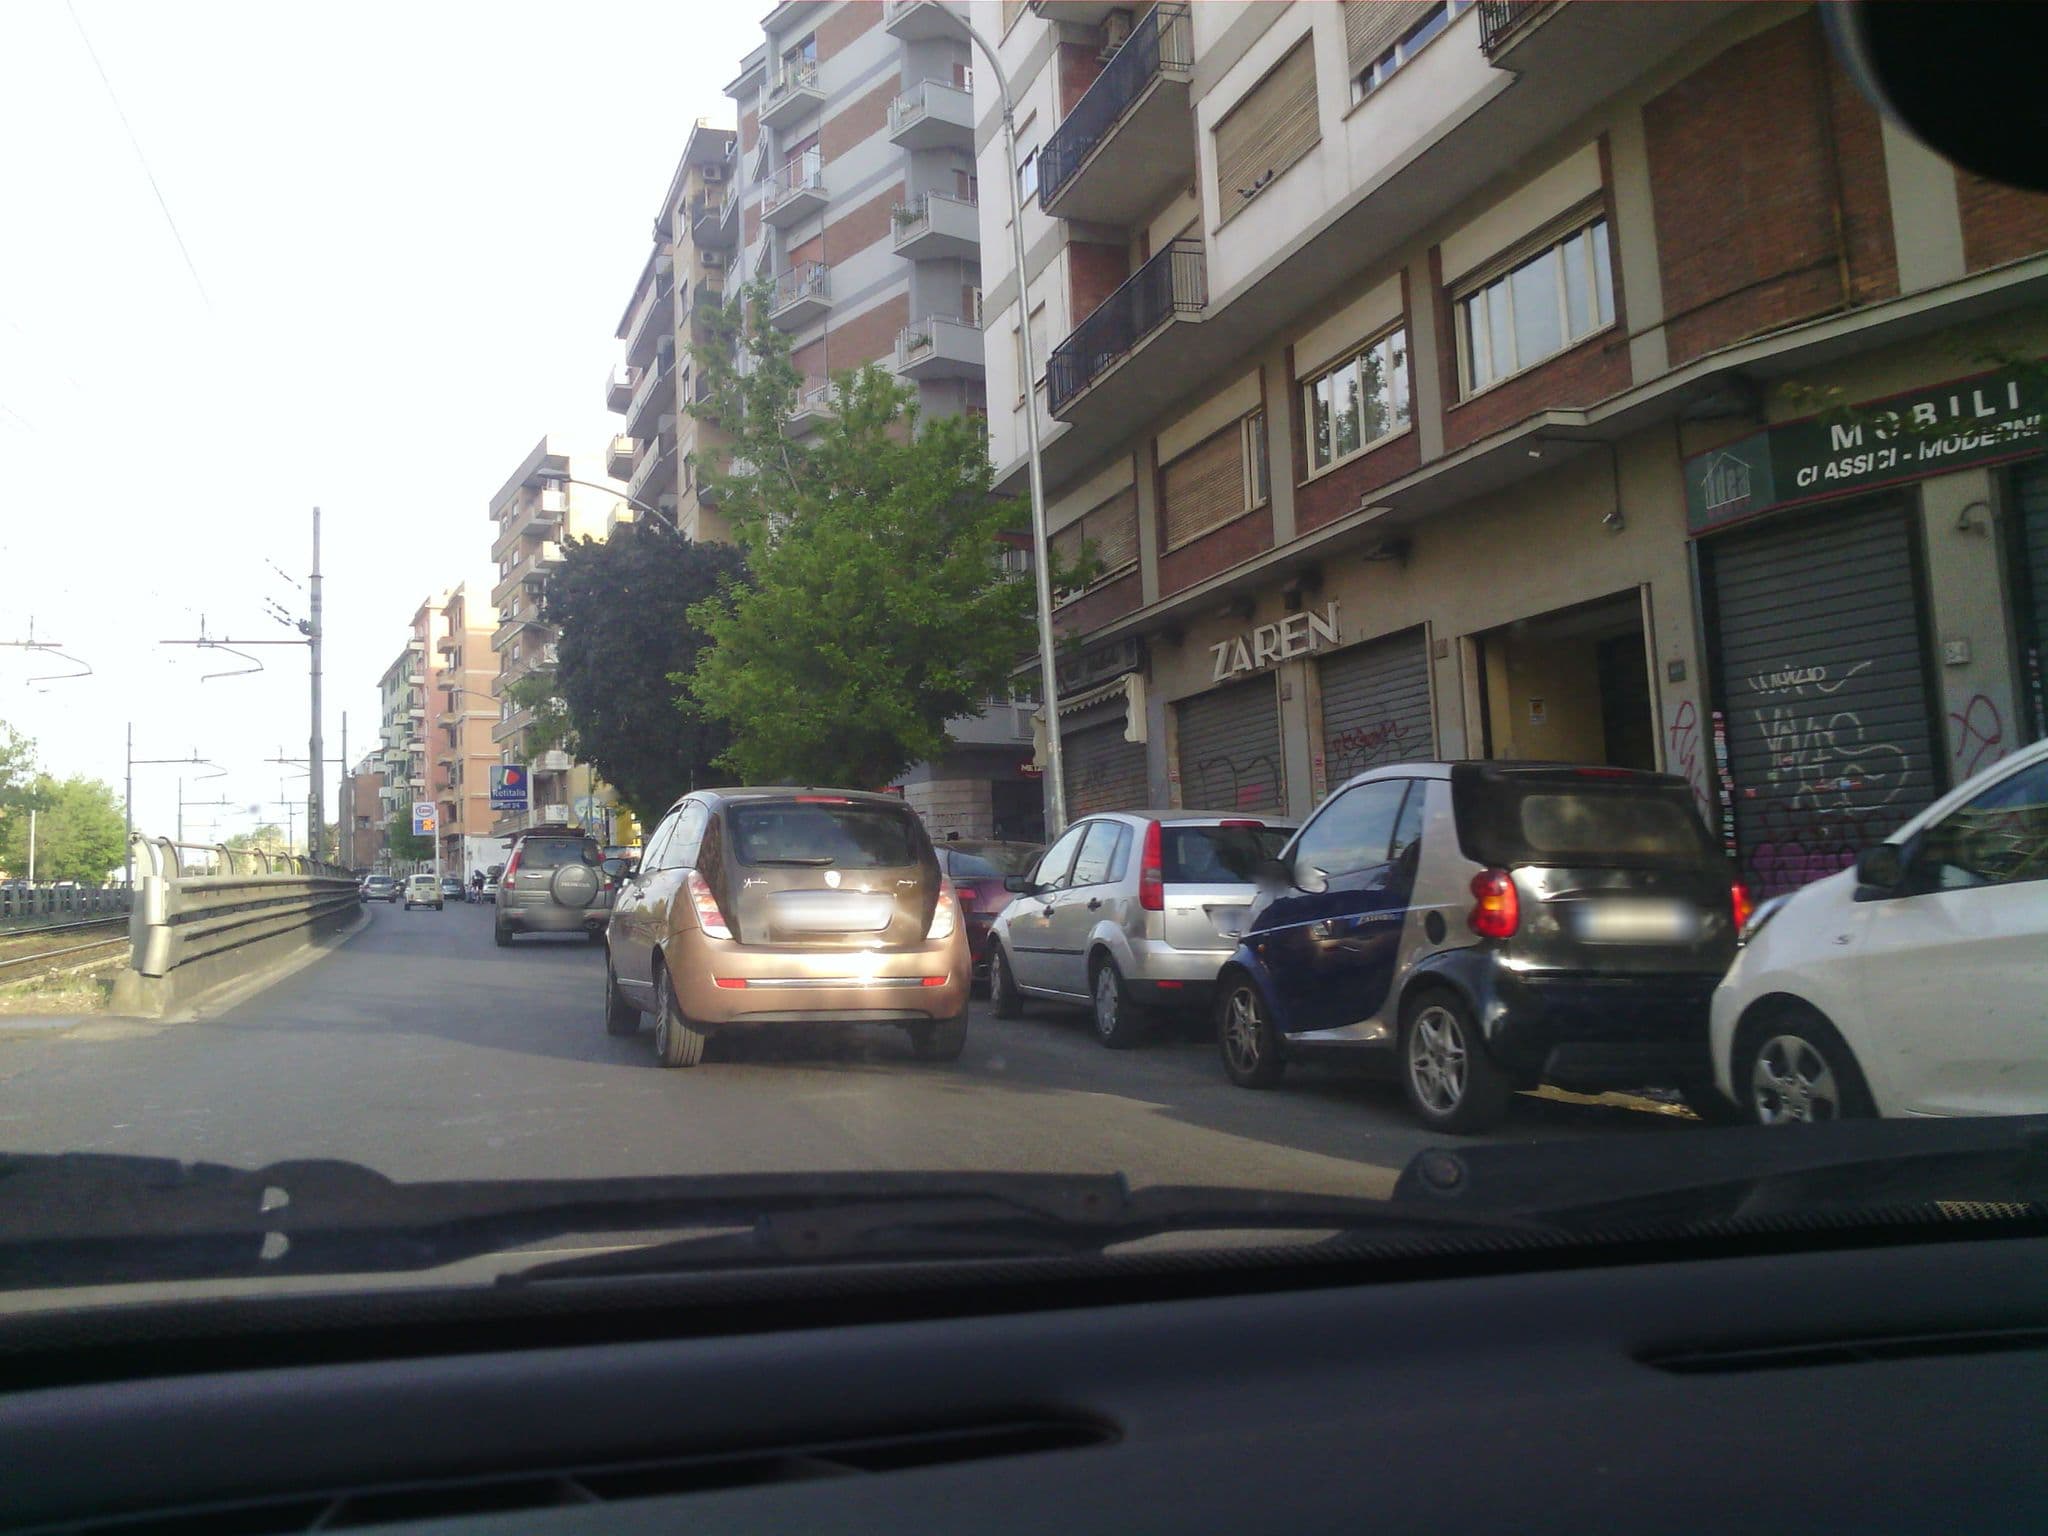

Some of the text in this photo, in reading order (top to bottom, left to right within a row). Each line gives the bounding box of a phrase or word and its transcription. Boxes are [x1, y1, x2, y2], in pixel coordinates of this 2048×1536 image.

[1830, 381, 2020, 451] MOBILI
[1208, 599, 1342, 683] ZAREN
[492, 788, 526, 798] Retitalia
